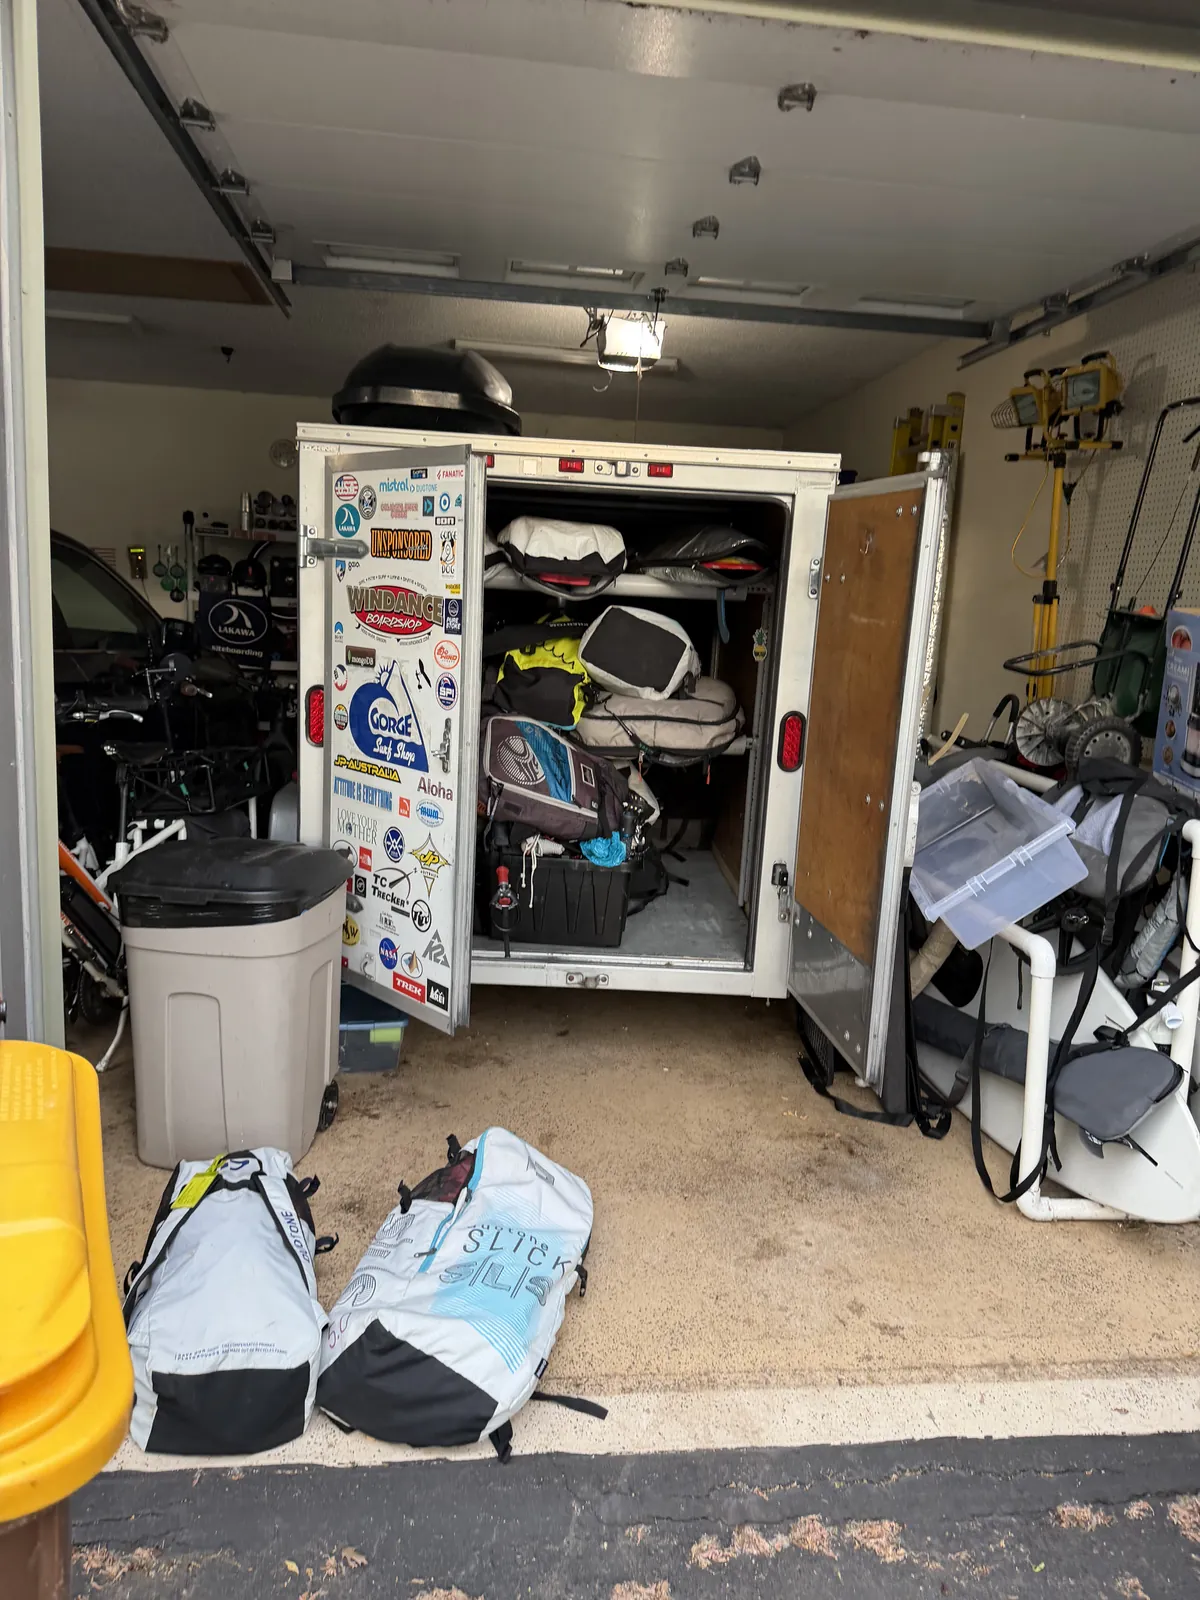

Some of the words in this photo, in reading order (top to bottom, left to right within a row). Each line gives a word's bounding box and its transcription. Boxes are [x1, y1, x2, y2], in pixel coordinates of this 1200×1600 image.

[442, 470, 464, 478] FANATIC
[379, 478, 409, 492] mistral
[416, 484, 438, 492] DUOTONE
[371, 530, 432, 560] UNSPONSORED
[441, 565, 455, 574] DOG
[346, 585, 445, 628] WINDANCE
[218, 625, 256, 637] LAKAWA
[365, 612, 423, 632] BOARDSHOP
[211, 644, 263, 658] kiteboarding
[351, 656, 375, 666] mongoDB
[440, 686, 455, 699] SPI
[370, 708, 412, 737] GORGE
[372, 736, 393, 761] Surf
[394, 741, 415, 766] Shop
[334, 755, 401, 783] JP-AUSTRALIA
[333, 776, 356, 800] ATTITUDE
[356, 782, 362, 802] IS
[362, 784, 393, 812] EVERYTHING
[416, 777, 454, 802] Aloha
[337, 808, 356, 825] LOVE
[357, 813, 378, 832] YOUR
[420, 850, 440, 867] JP
[373, 873, 387, 888] TC
[380, 946, 397, 960] NASA
[396, 978, 421, 997] TREK
[281, 1210, 310, 1264] DUOTONE
[462, 1228, 572, 1280] SLICK
